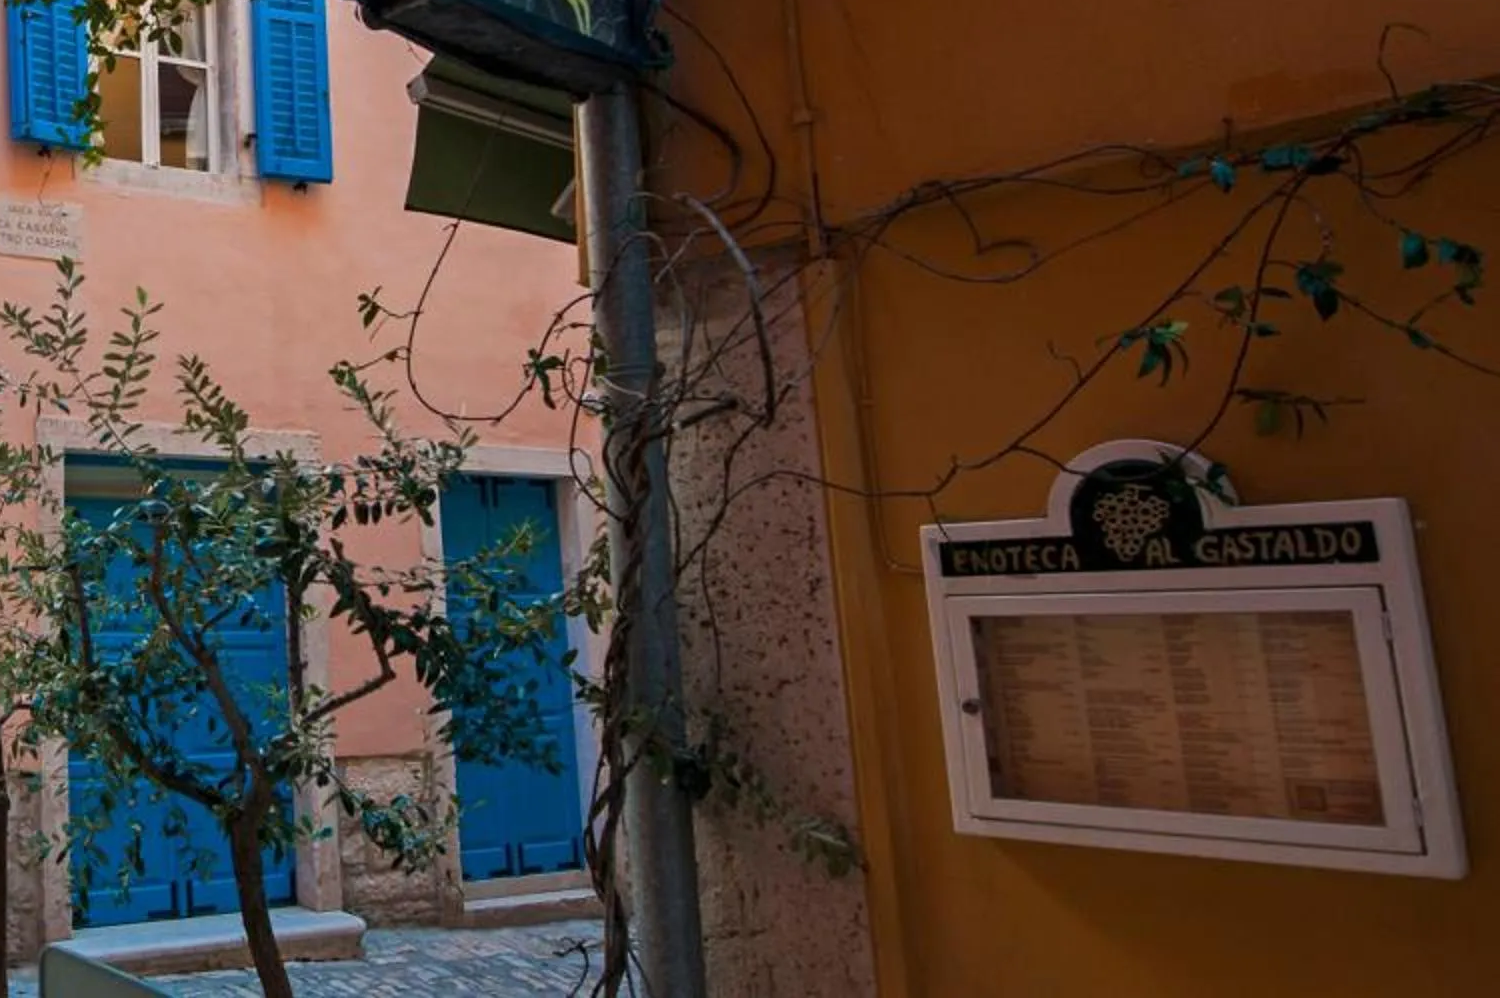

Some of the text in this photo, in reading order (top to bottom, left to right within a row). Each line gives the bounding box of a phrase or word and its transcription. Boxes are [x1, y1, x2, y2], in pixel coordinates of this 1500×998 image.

[953, 526, 1362, 573] ENOTECA AL GASTALDO
